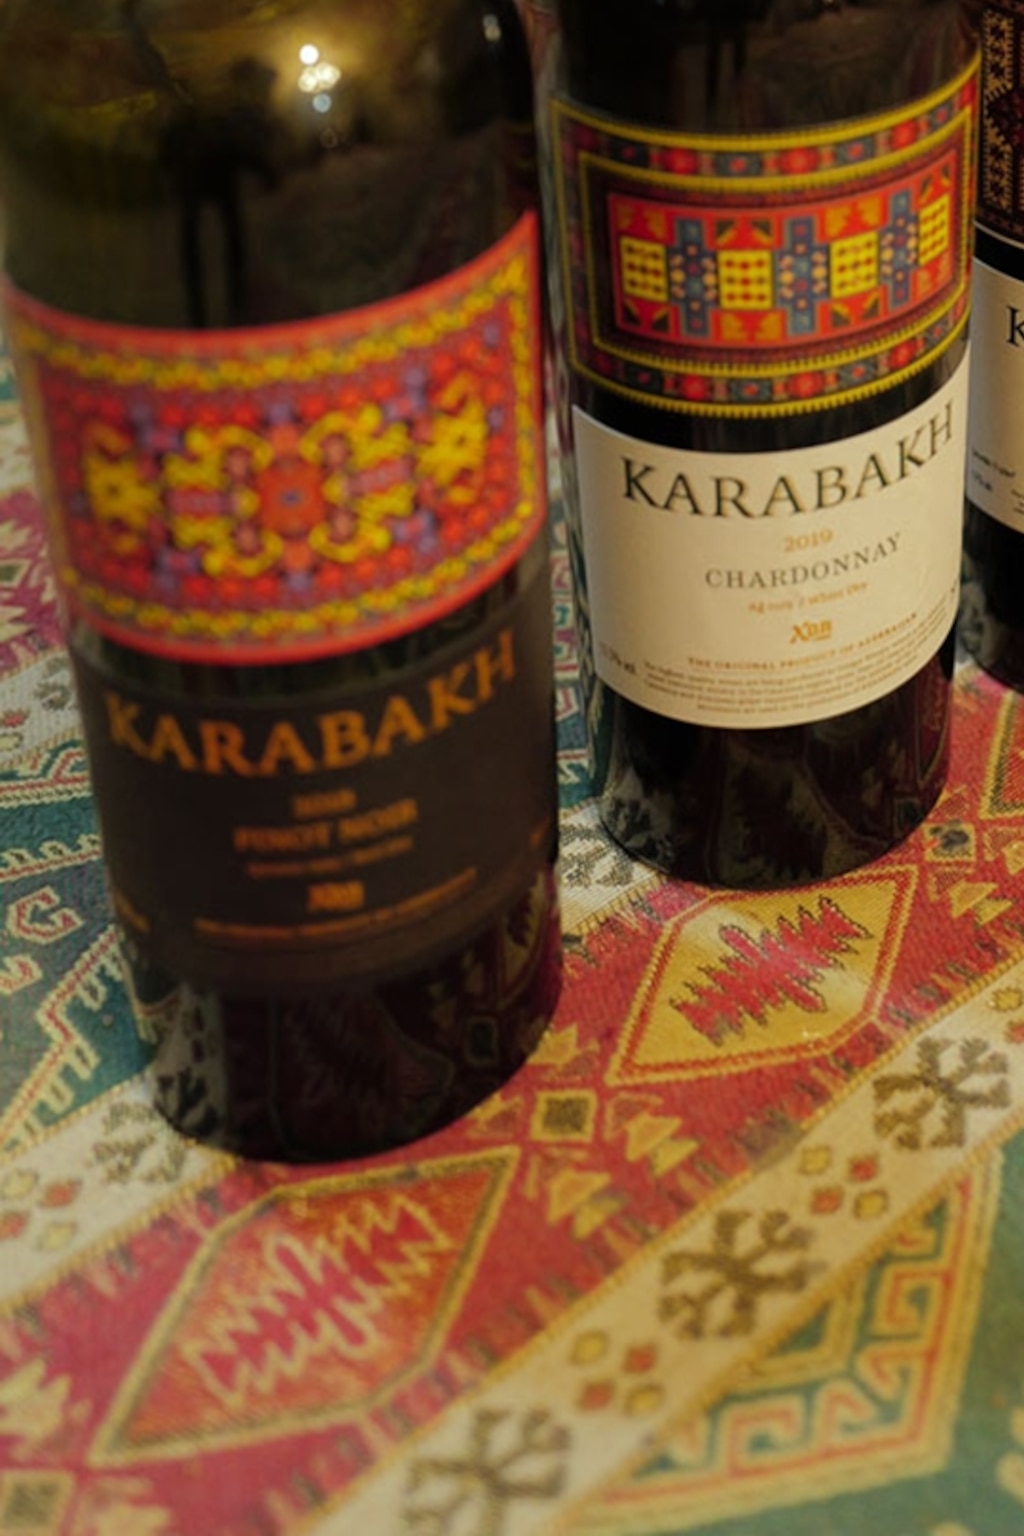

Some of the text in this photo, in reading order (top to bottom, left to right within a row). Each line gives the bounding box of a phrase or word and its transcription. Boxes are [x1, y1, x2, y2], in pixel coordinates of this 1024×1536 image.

[620, 398, 955, 519] KARABAKH
[705, 532, 900, 589] CHARDONNAY
[783, 528, 834, 553] 2019
[106, 629, 517, 776] KARABAKH
